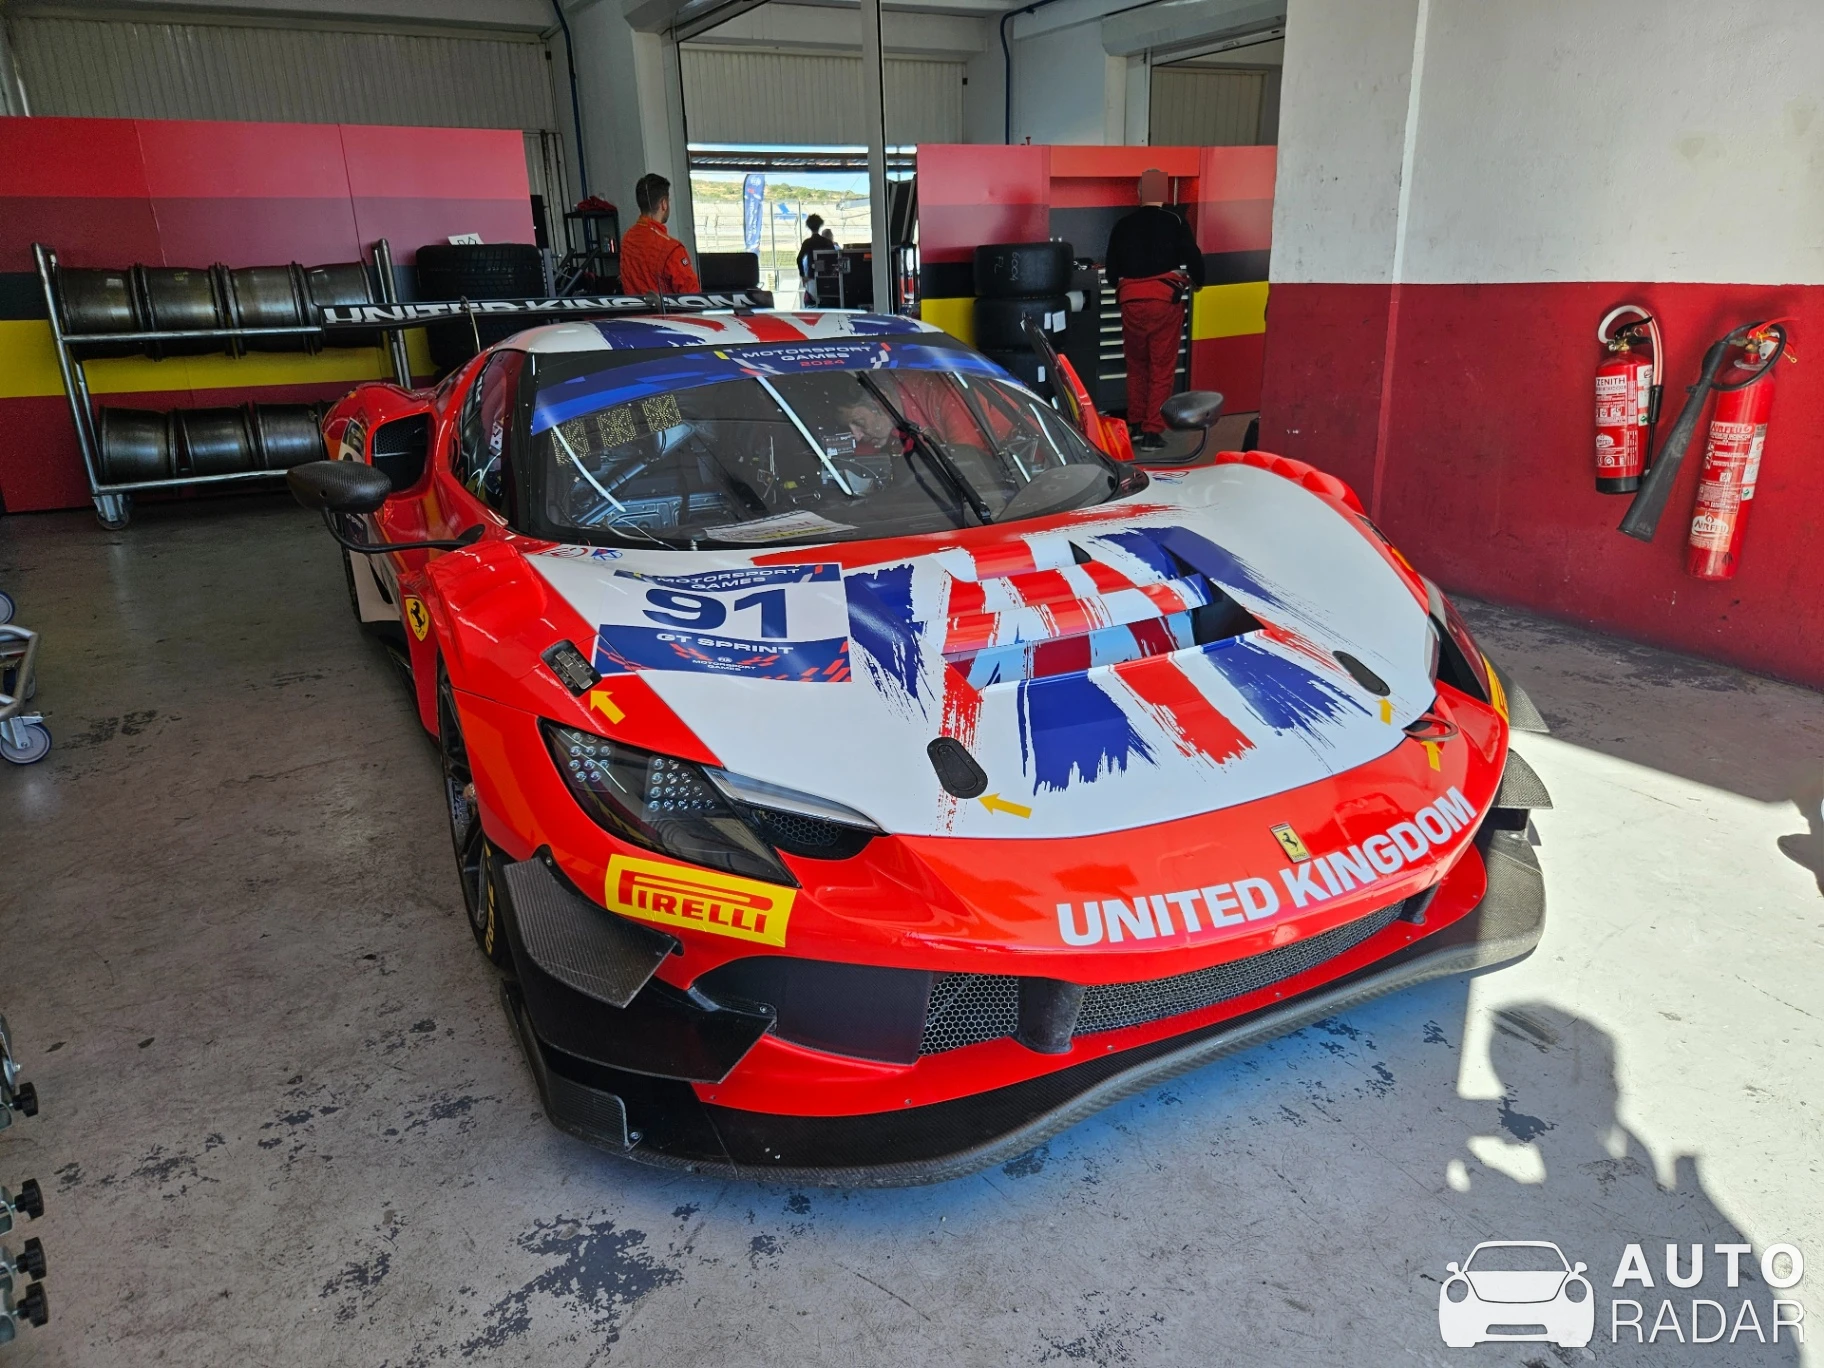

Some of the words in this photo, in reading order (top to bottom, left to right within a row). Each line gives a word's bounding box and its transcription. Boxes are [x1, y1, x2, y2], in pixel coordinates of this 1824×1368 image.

[324, 301, 521, 324] UNITED
[741, 346, 872, 359] MOTORSPORT
[780, 352, 850, 361] GAMES
[800, 359, 845, 367] 2024
[1596, 377, 1625, 386] ZENITH
[1694, 520, 1728, 533] AIRFEU
[657, 568, 800, 583] MOTORSPORT
[691, 577, 766, 589] GAMES
[642, 588, 788, 639] 91
[656, 633, 692, 643] GT
[697, 638, 794, 655] SPRINT
[692, 659, 757, 670] MOTORSPORT
[1056, 877, 1279, 947] UNITED
[1279, 785, 1478, 908] KINGDOM
[618, 869, 773, 934] PIRELLI
